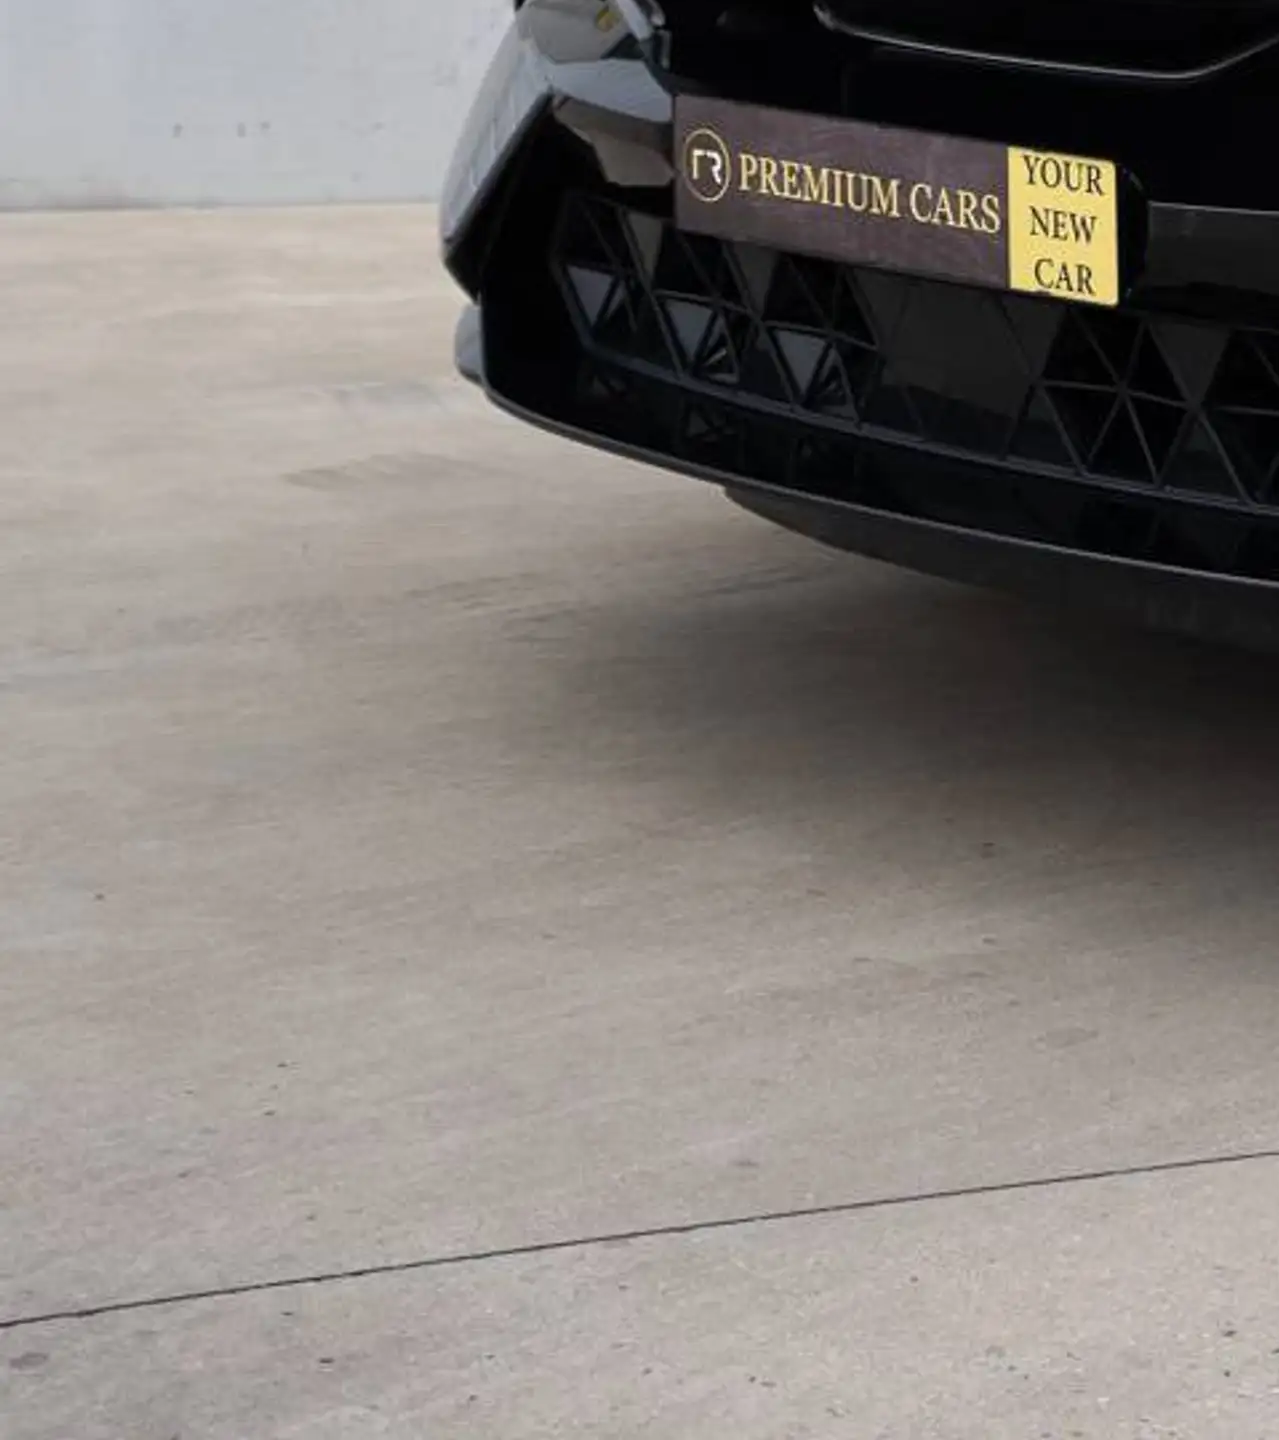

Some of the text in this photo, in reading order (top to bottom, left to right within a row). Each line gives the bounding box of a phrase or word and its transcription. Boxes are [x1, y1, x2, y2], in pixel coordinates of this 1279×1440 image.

[739, 153, 1000, 234] PREMIUM CARS
[1022, 154, 1105, 196] YOUR
[1029, 205, 1096, 244] NEW
[1034, 258, 1095, 296] CAR
